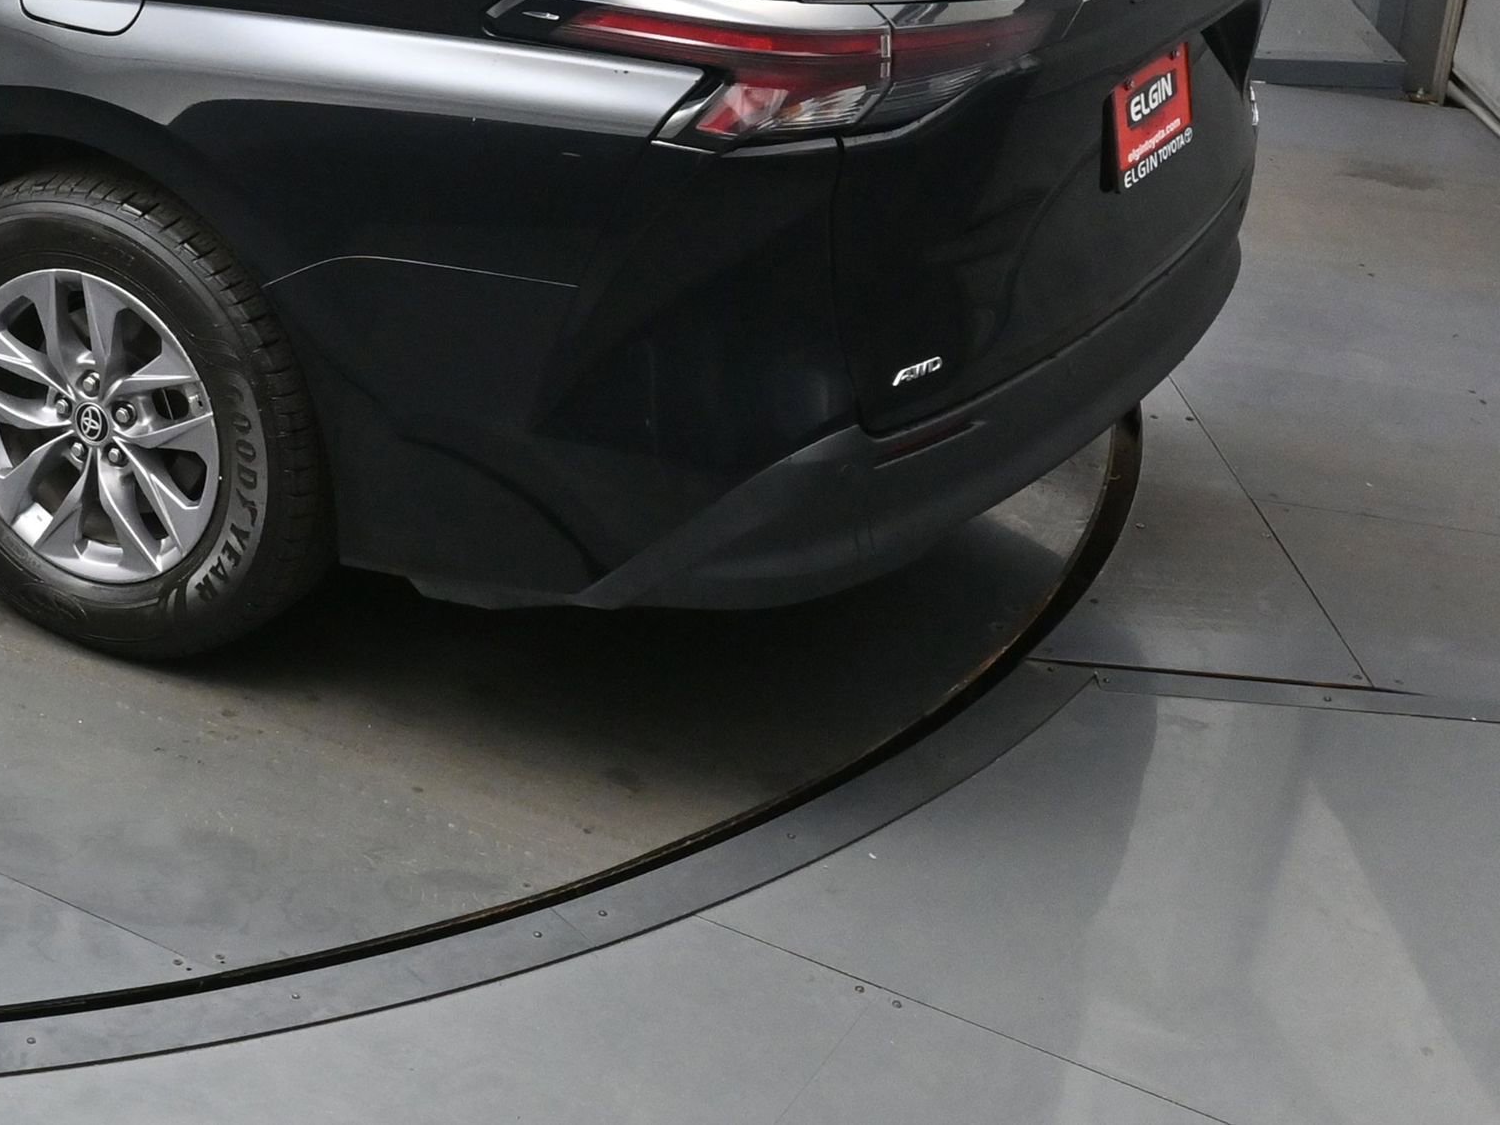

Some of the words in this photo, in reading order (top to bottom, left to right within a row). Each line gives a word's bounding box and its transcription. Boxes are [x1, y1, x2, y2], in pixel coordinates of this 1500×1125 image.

[1130, 72, 1173, 122] ELGIN
[1123, 150, 1158, 189] ELGIN
[1158, 134, 1184, 164] TOYOTA
[1127, 117, 1181, 163] elgintoyota.com
[892, 356, 943, 387] AWD
